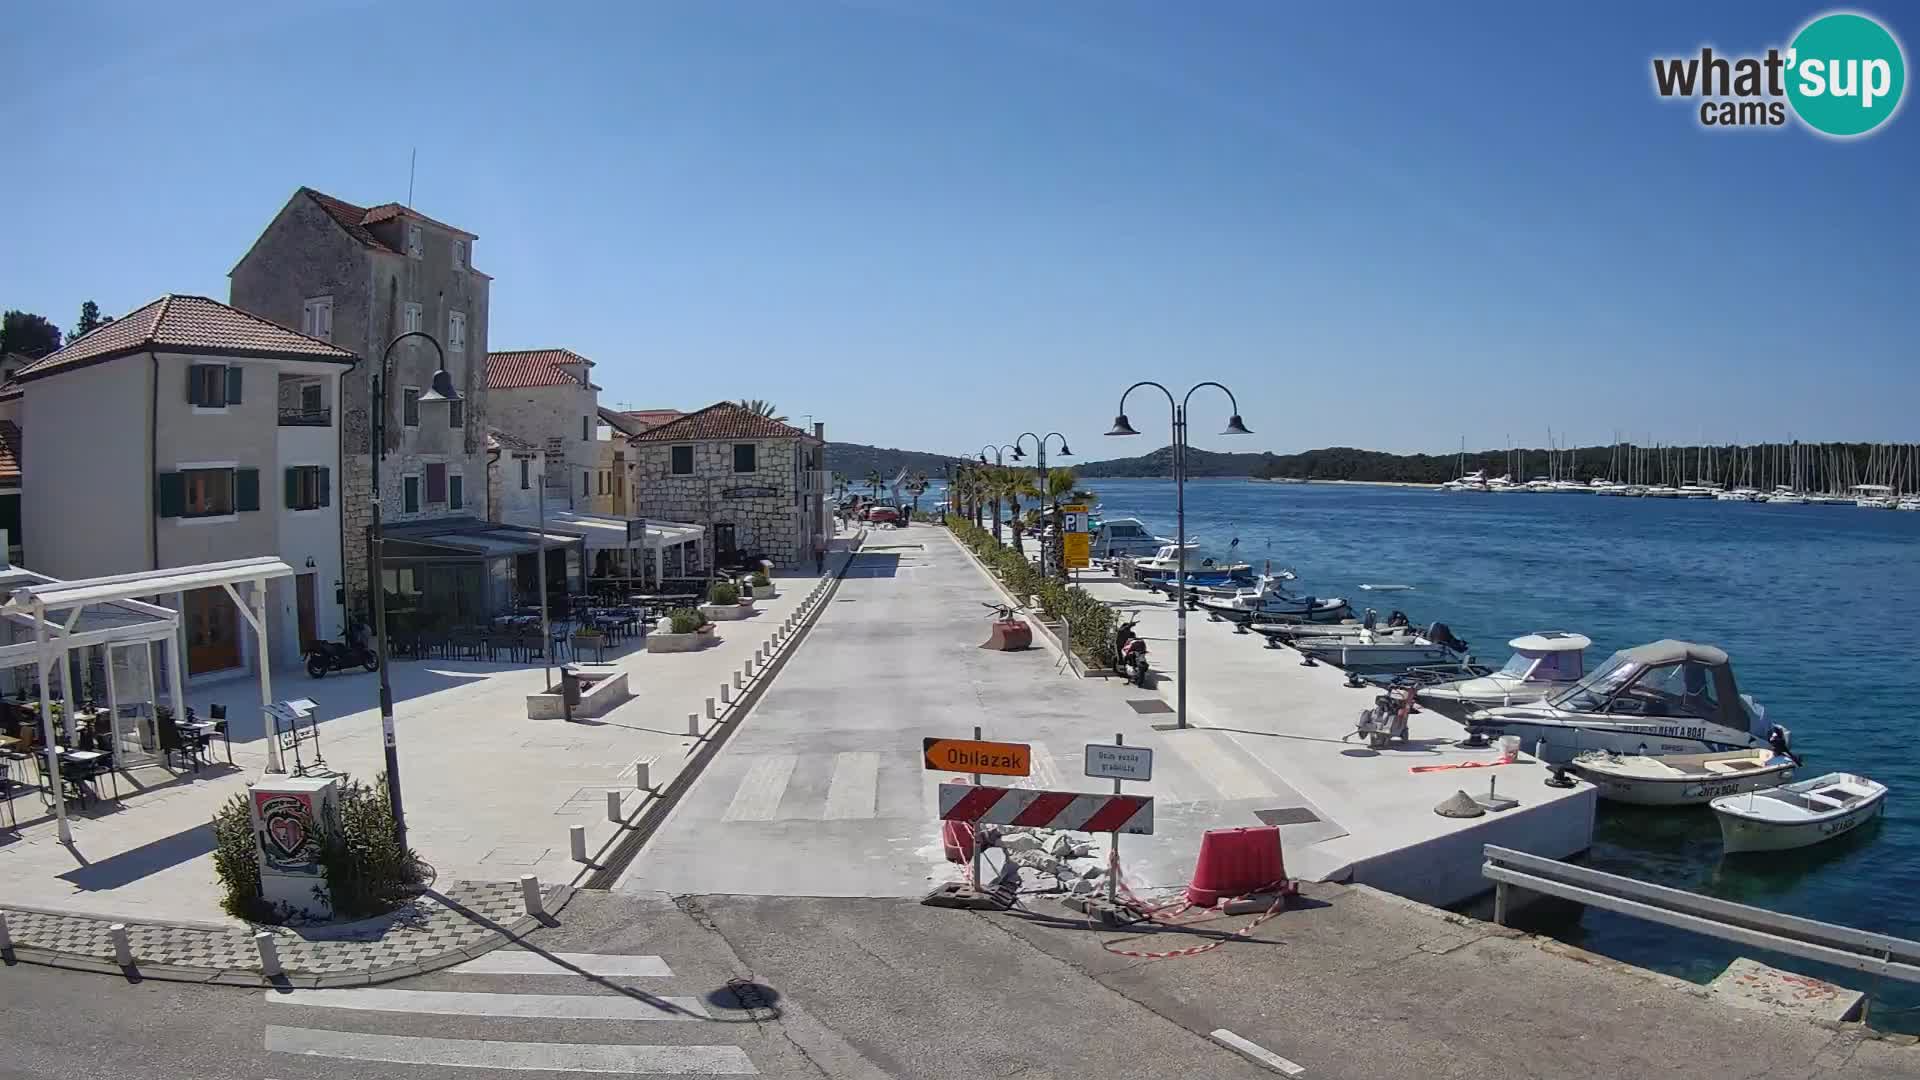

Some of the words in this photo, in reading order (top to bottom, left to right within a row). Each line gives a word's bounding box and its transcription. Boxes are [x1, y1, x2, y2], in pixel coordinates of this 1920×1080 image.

[1066, 515, 1075, 530] P
[1658, 726, 1679, 737] RENT
[1679, 727, 1685, 737] A
[1687, 727, 1707, 739] BOAT
[947, 748, 1021, 768] Obilazak
